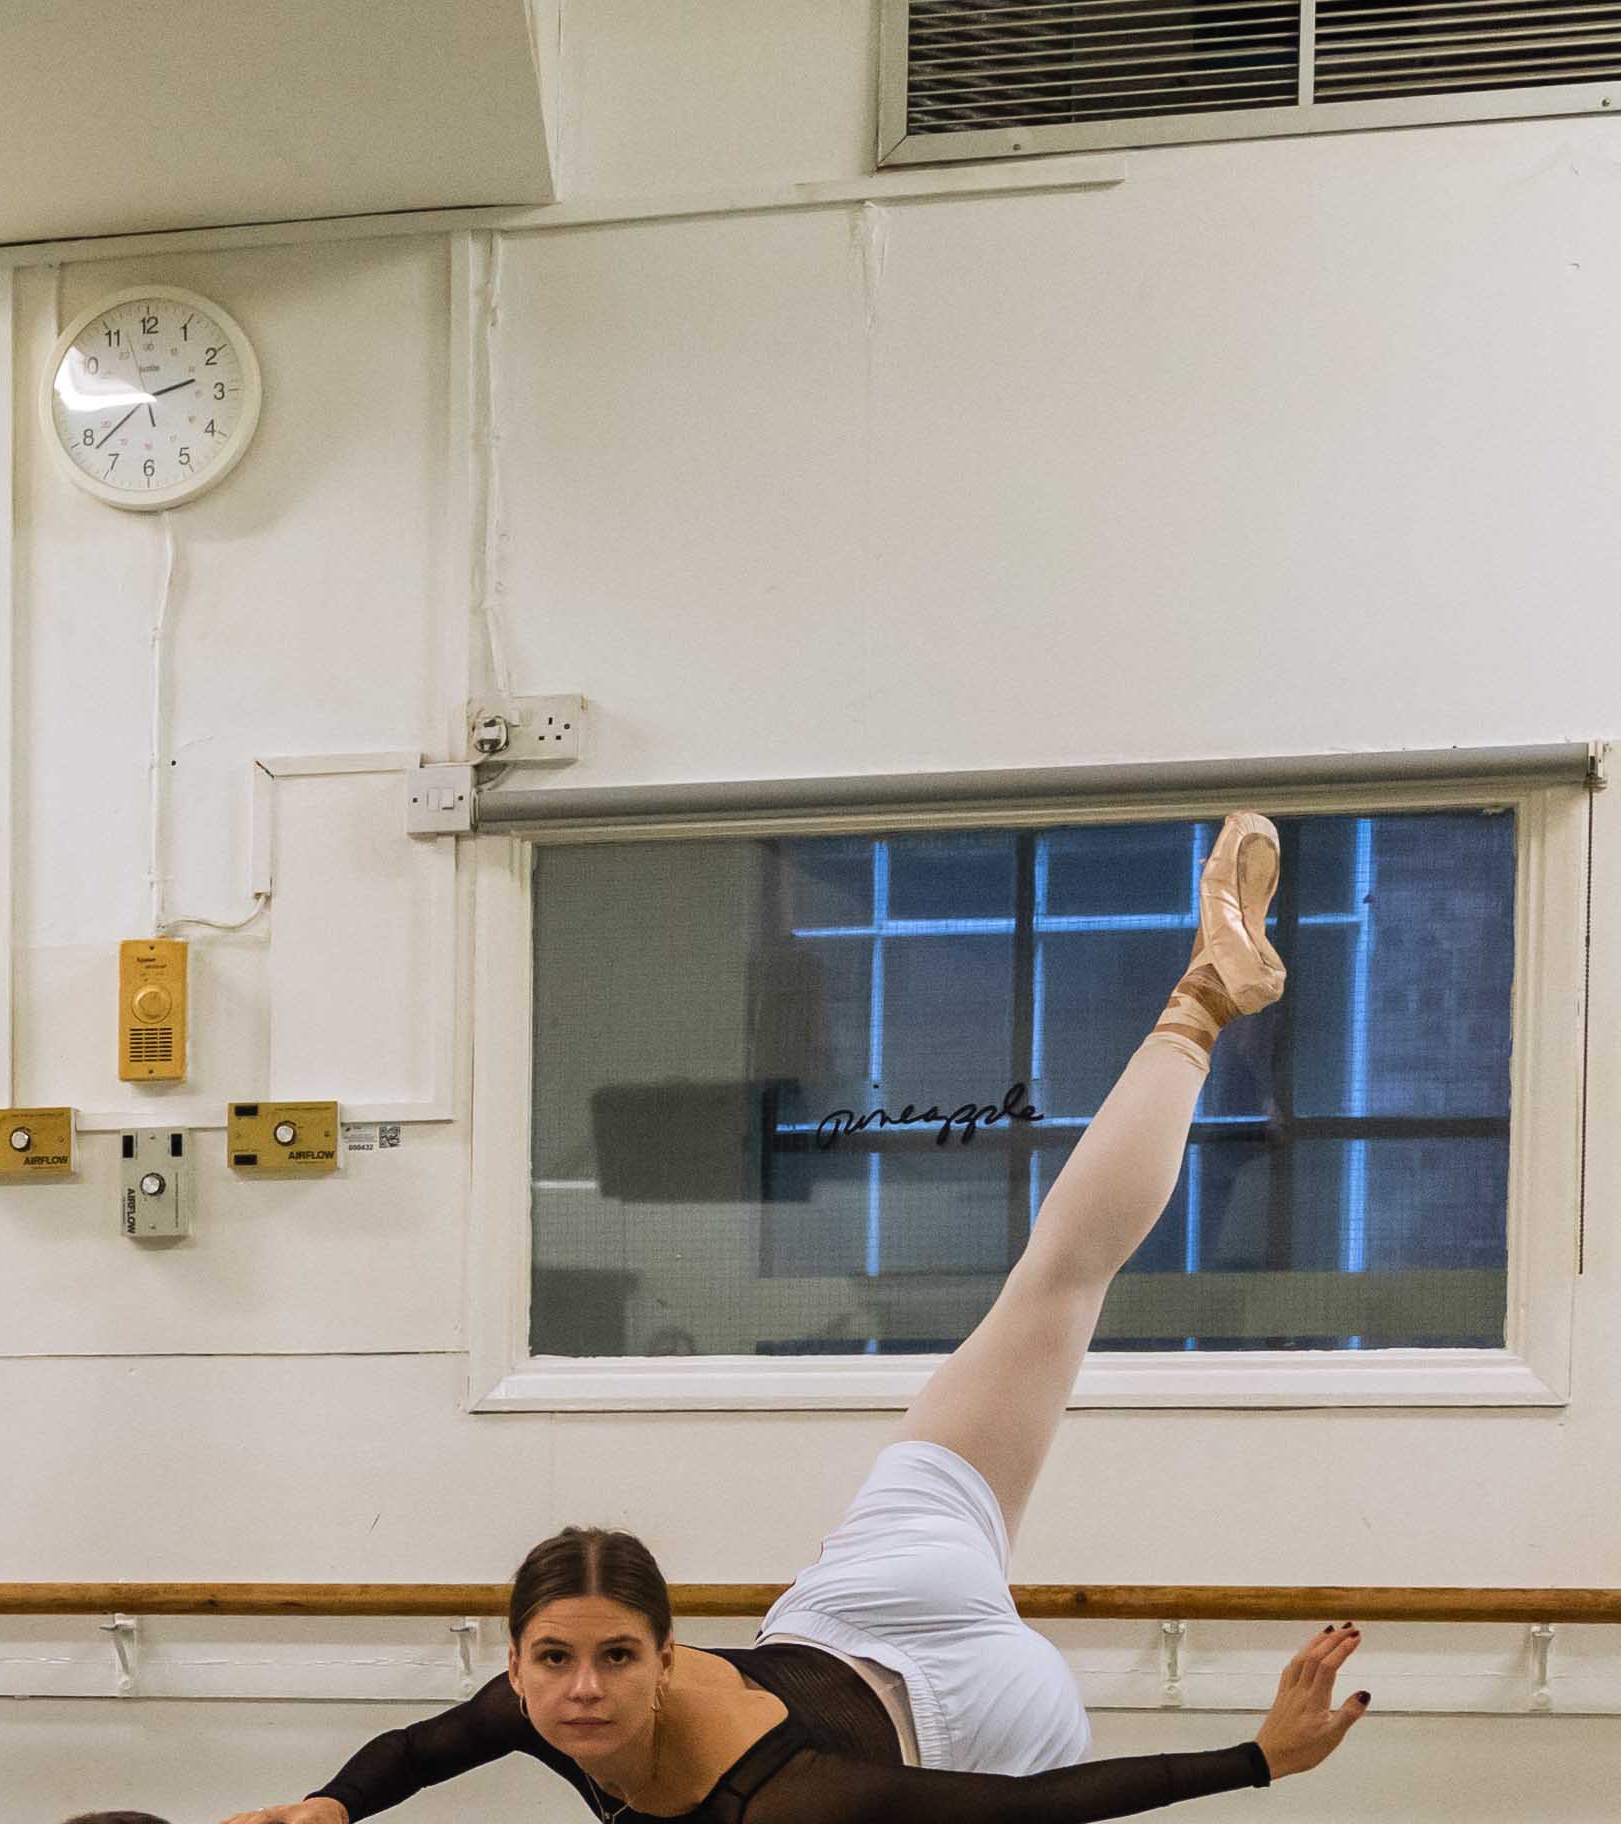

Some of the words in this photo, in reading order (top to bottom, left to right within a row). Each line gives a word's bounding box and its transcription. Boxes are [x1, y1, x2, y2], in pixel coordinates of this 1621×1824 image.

[141, 316, 159, 334] 12
[181, 323, 188, 341] 1
[104, 329, 120, 347] 11
[205, 347, 217, 366] 2
[213, 382, 225, 400] 3
[83, 428, 94, 446] 8
[205, 419, 217, 437] 4
[108, 453, 120, 471] 7
[179, 447, 190, 465] 5
[143, 459, 155, 477] 6
[23, 1156, 69, 1166] AIRFLOW
[288, 1150, 335, 1161] AIRFLOW
[127, 1187, 137, 1234] AIRFLOW
